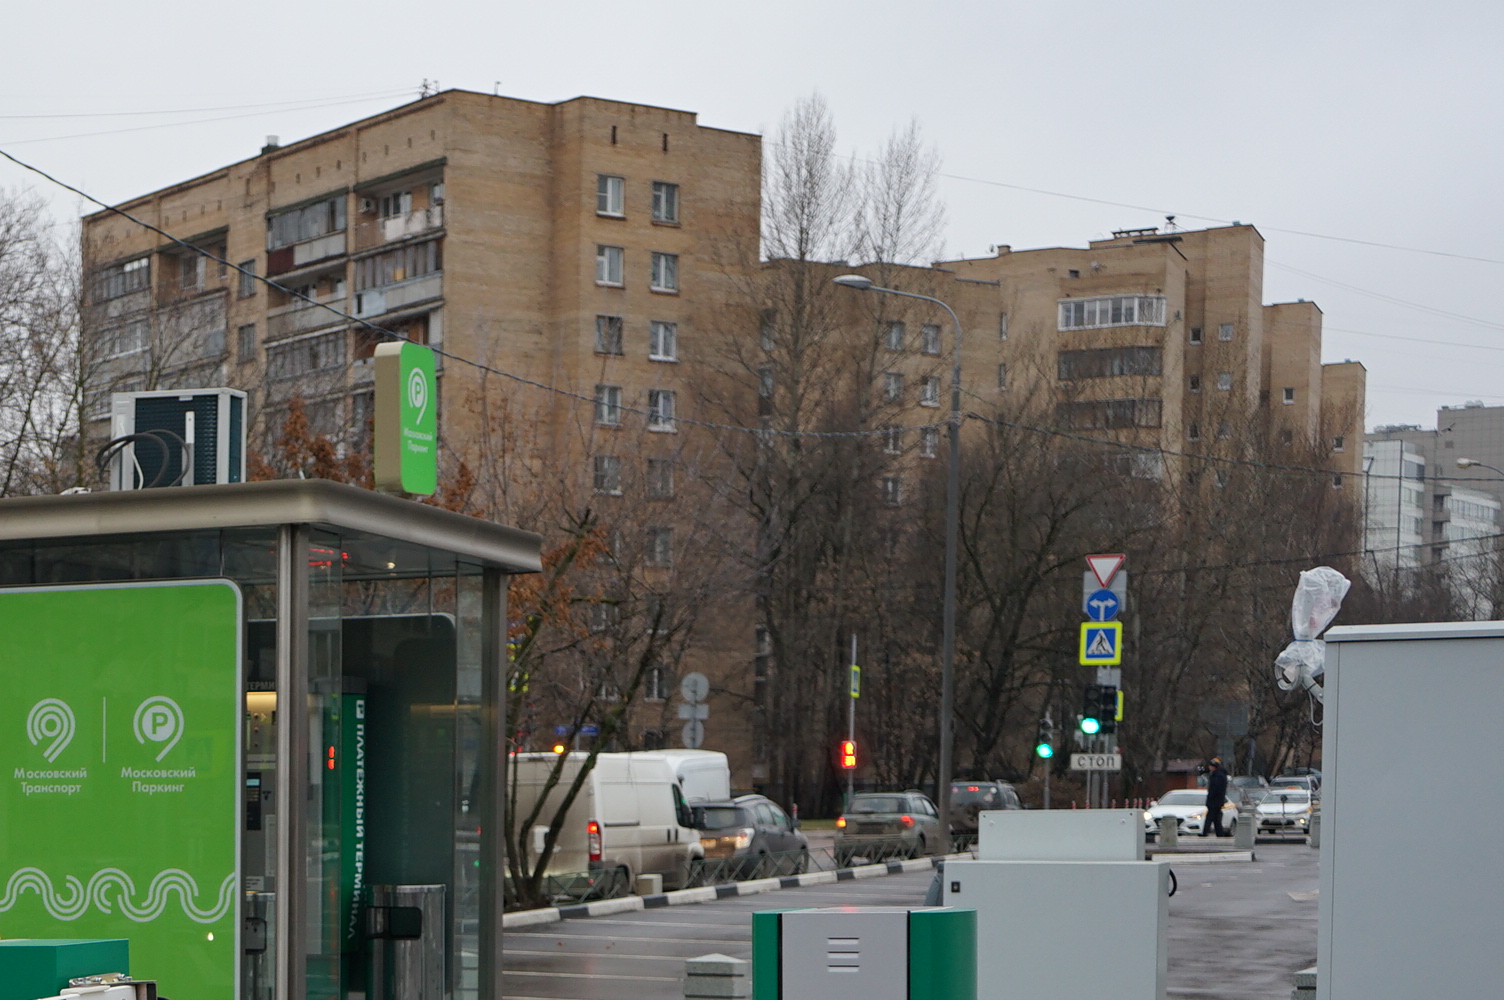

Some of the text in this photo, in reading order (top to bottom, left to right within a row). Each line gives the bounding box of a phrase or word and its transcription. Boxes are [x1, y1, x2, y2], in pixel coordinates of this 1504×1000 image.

[1077, 755, 1115, 768] СТОП
[13, 767, 87, 779] Московский
[120, 766, 196, 778] Московский
[20, 781, 82, 796] Транспорт
[131, 781, 184, 796] Паркинг
[347, 723, 365, 939] ПЛАТЕЖНЫЙ ТЕРМИНАЛ
